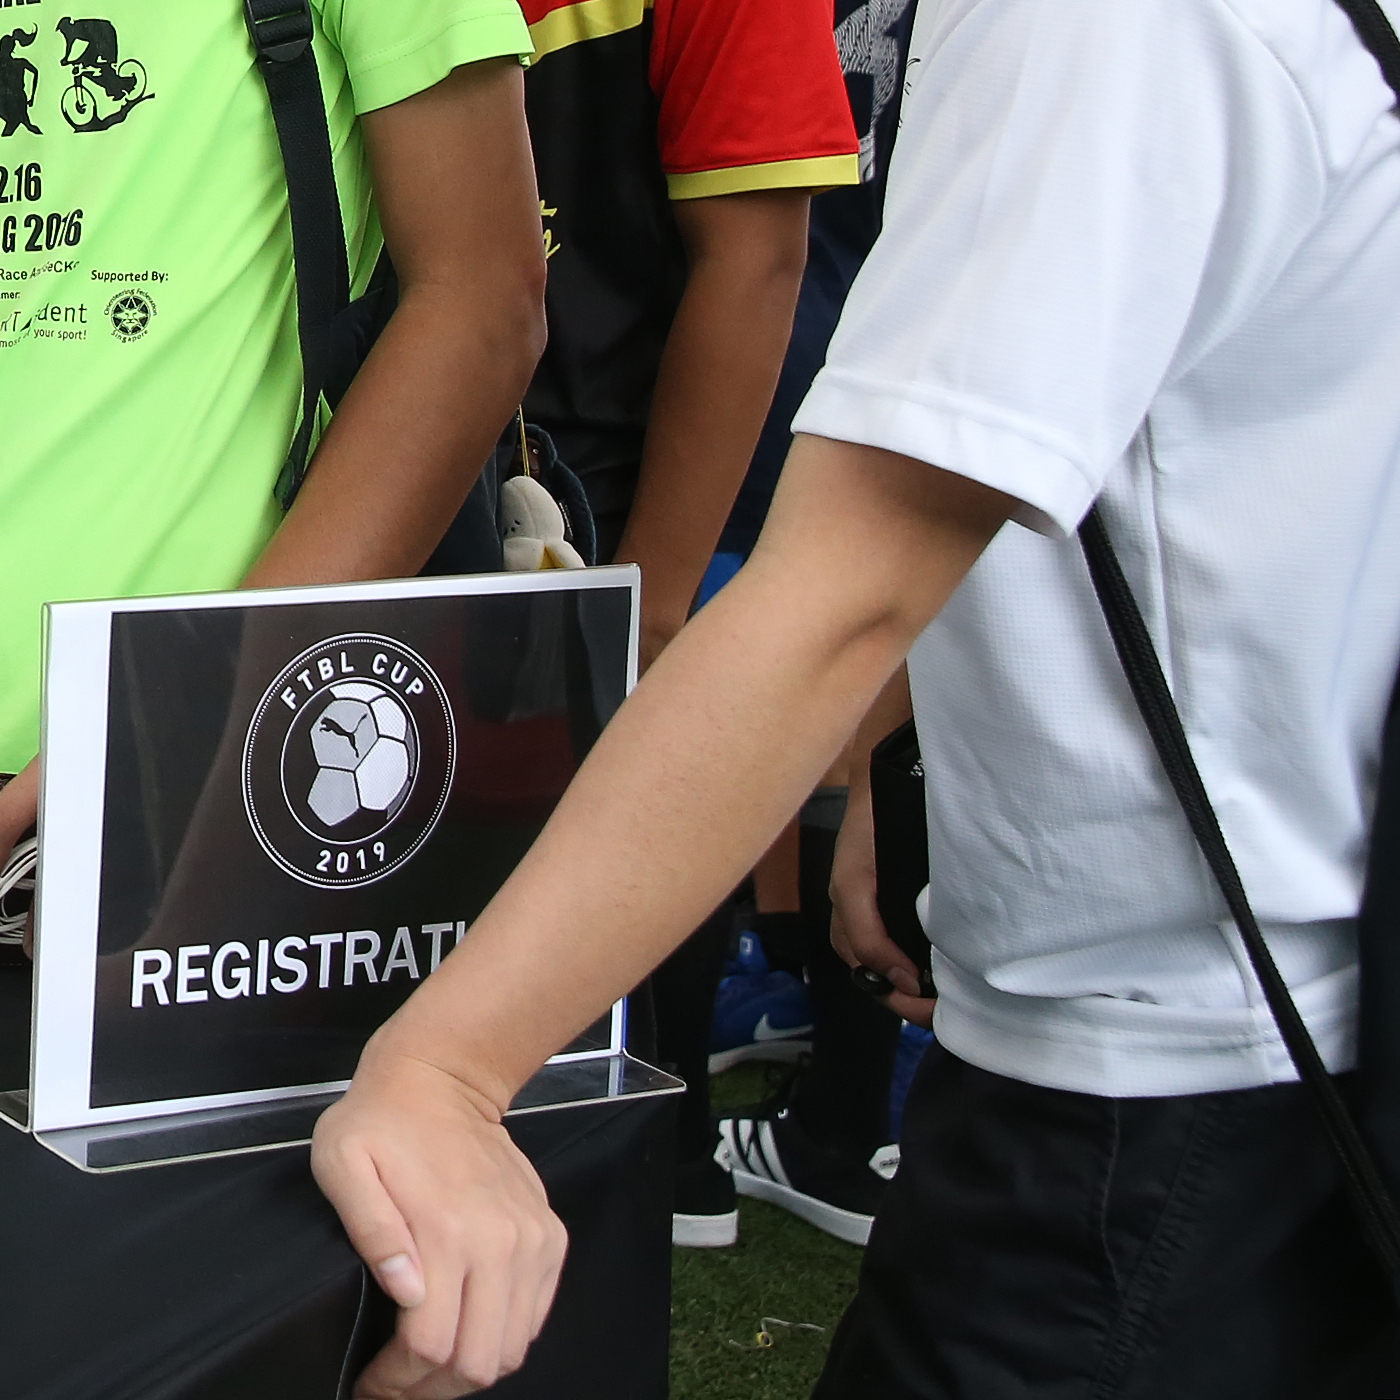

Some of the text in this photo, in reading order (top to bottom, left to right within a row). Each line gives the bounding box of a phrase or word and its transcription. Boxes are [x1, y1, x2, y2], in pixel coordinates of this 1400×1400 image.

[23, 208, 84, 252] 2016
[90, 270, 169, 283] Supported By:
[33, 328, 55, 339] your
[57, 329, 87, 341] sport!
[110, 330, 149, 344] Singapore
[280, 651, 425, 711] FTBL CUP
[315, 841, 386, 874] 2019
